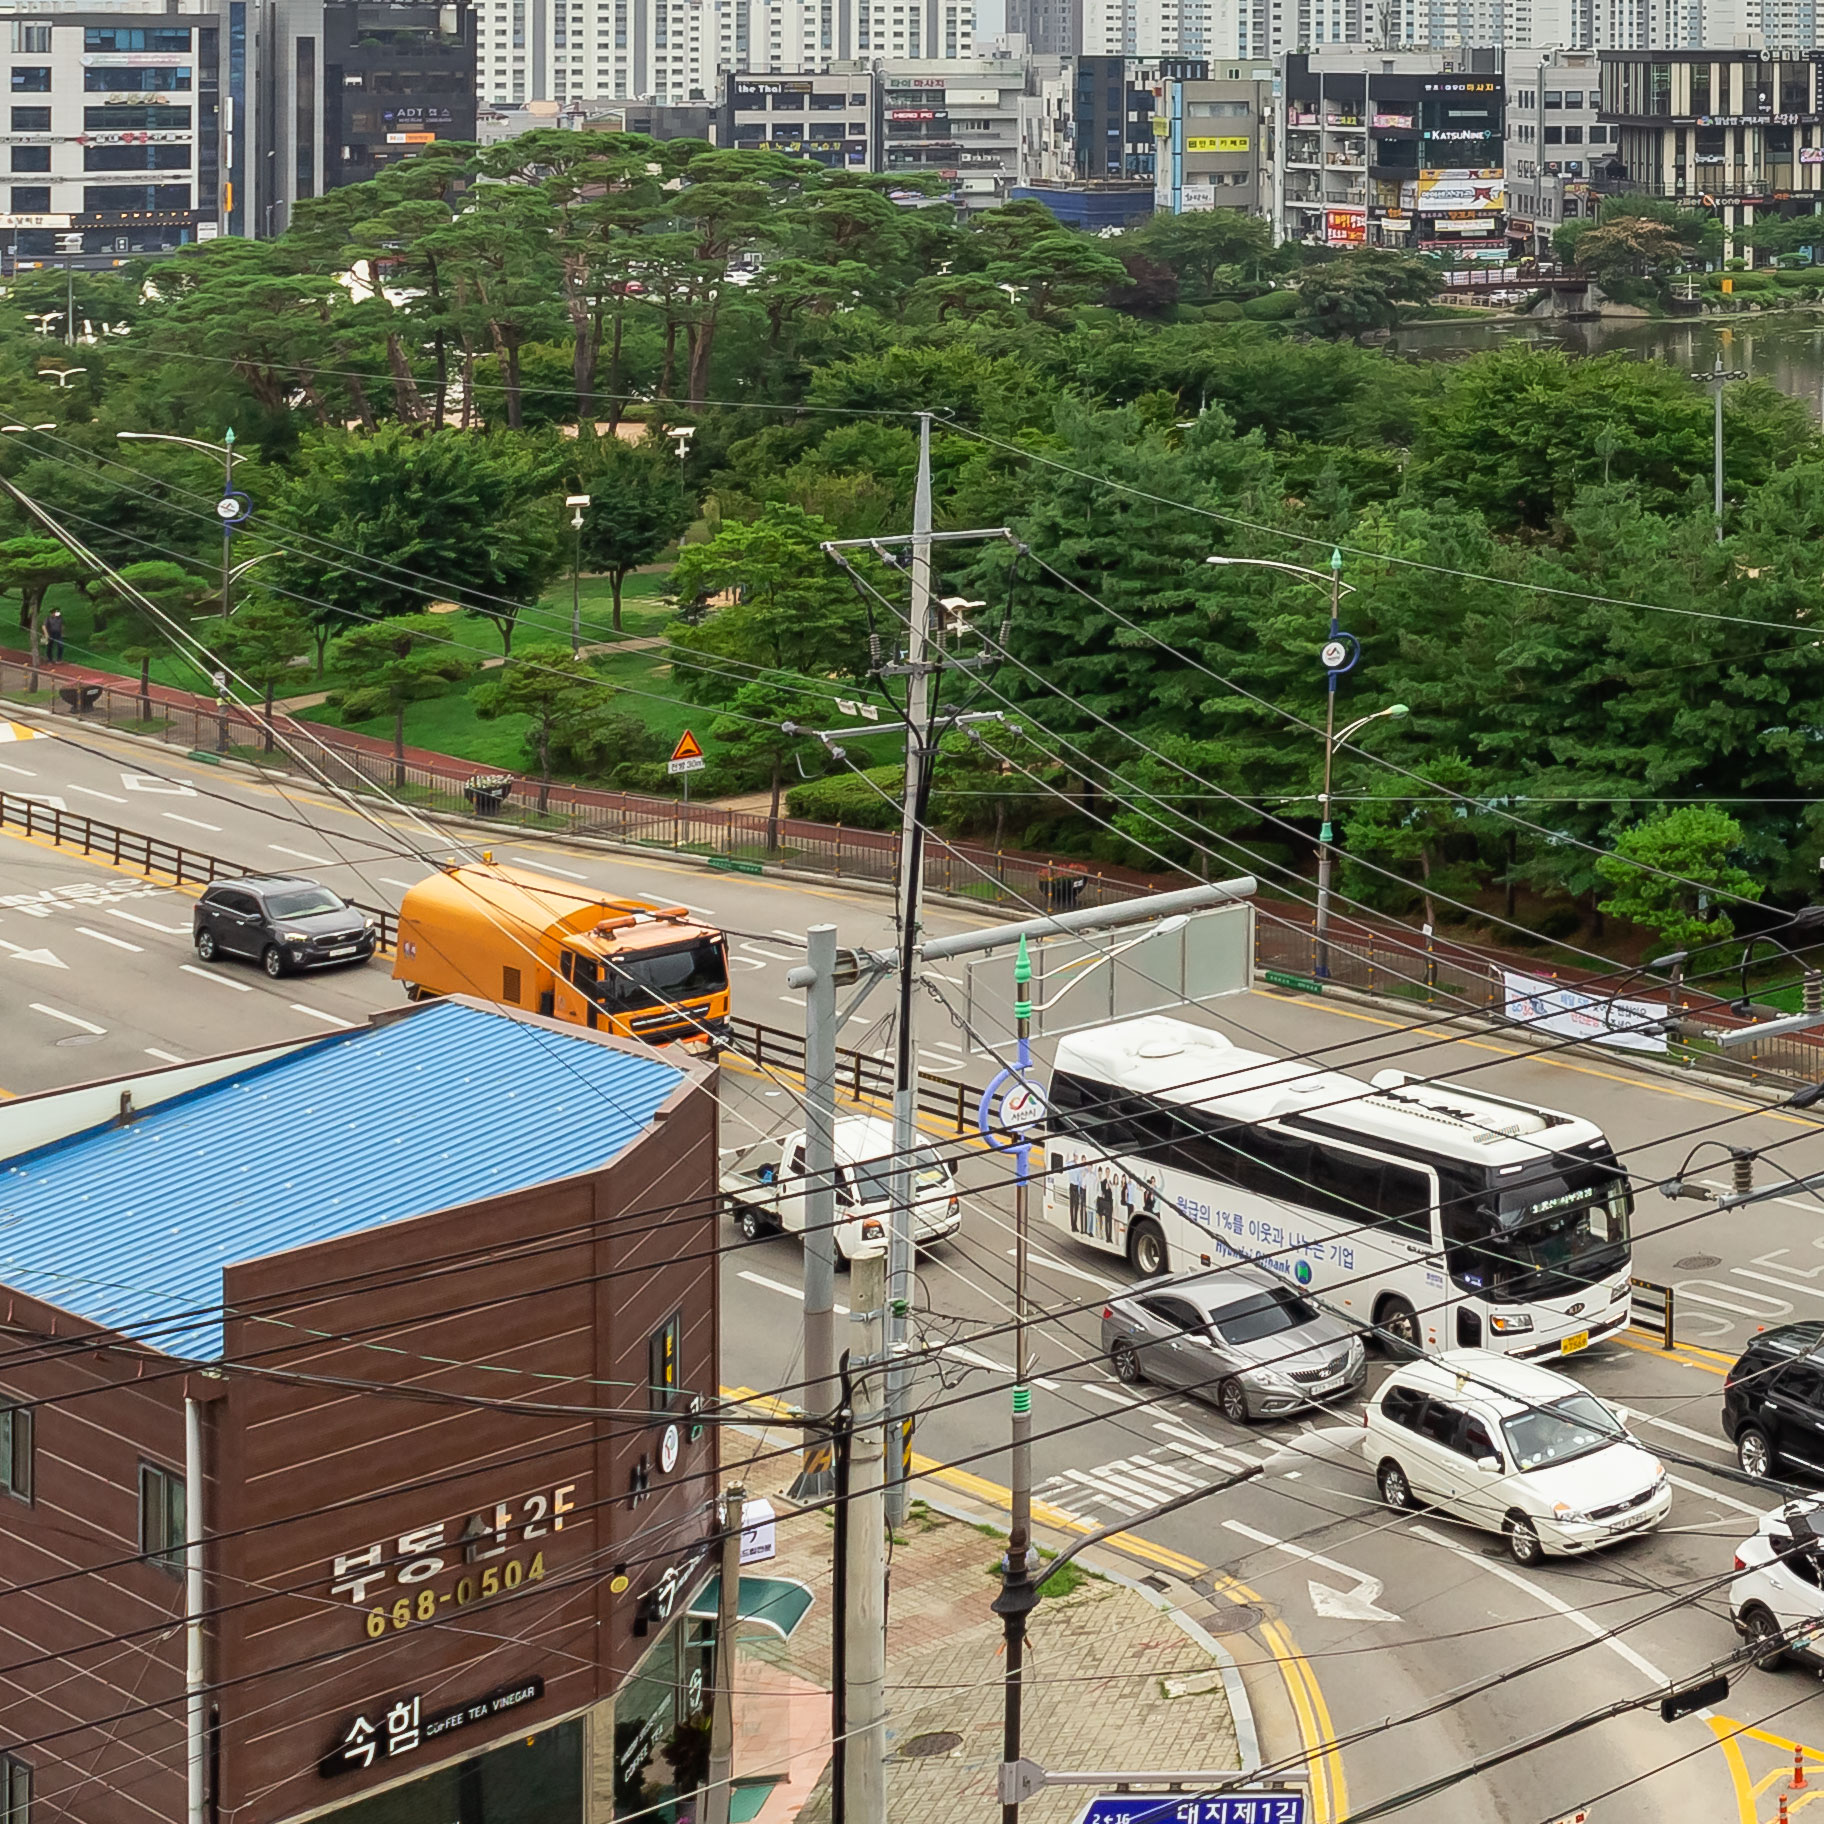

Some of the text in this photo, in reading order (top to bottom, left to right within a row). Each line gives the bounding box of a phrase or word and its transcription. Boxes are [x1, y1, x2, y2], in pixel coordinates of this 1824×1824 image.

[738, 84, 782, 94] the Thai
[913, 79, 945, 88] 마사지
[397, 108, 423, 117] ADT
[1011, 1109, 1036, 1121] 서산시
[1216, 1210, 1244, 1236] 1%를
[1249, 1220, 1284, 1249] 이웃과
[1330, 1245, 1355, 1271] 기업
[1569, 1304, 1583, 1315] KIA
[331, 1484, 575, 1605] 부동산 2F
[366, 1550, 546, 1639] 668-0504
[468, 1706, 488, 1720] TEA
[492, 1686, 535, 1711] VINEGAR
